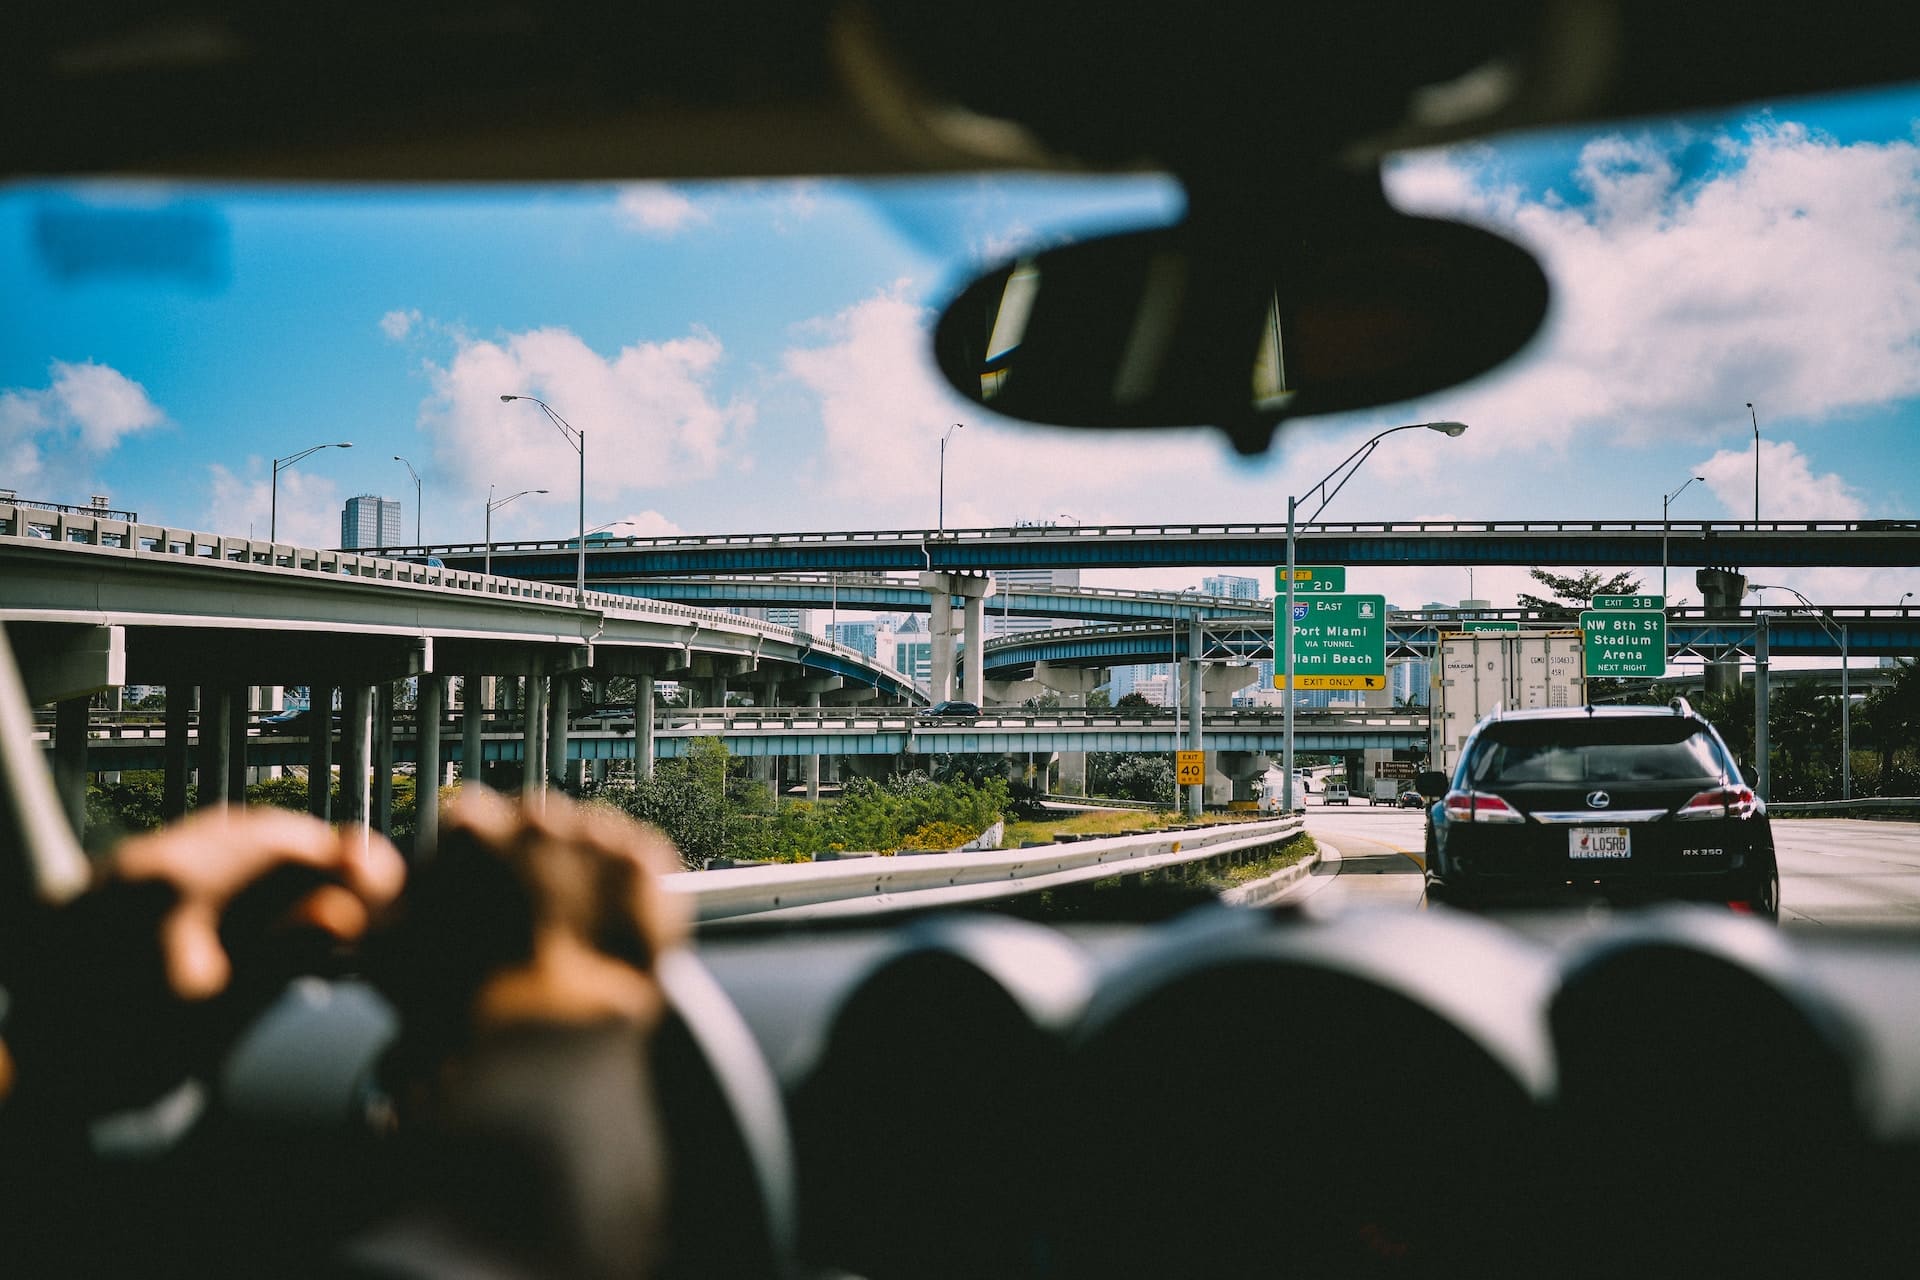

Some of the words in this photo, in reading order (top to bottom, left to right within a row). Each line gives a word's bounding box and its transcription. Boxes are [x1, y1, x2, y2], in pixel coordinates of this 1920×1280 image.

[1284, 571, 1307, 579] LFT
[1316, 602, 1342, 610] EAST
[1604, 599, 1623, 607] EXIT
[1587, 620, 1606, 630] NW
[1613, 620, 1636, 631] 8th
[1643, 620, 1658, 631] St
[1293, 626, 1320, 636] Port
[1327, 626, 1367, 636] Miami
[1594, 634, 1651, 645] Stadium
[1333, 654, 1372, 664] Beach
[1602, 650, 1642, 660] Arena
[1303, 678, 1323, 686] EXIT
[1329, 678, 1354, 686] ONLY
[1181, 766, 1200, 776] 40
